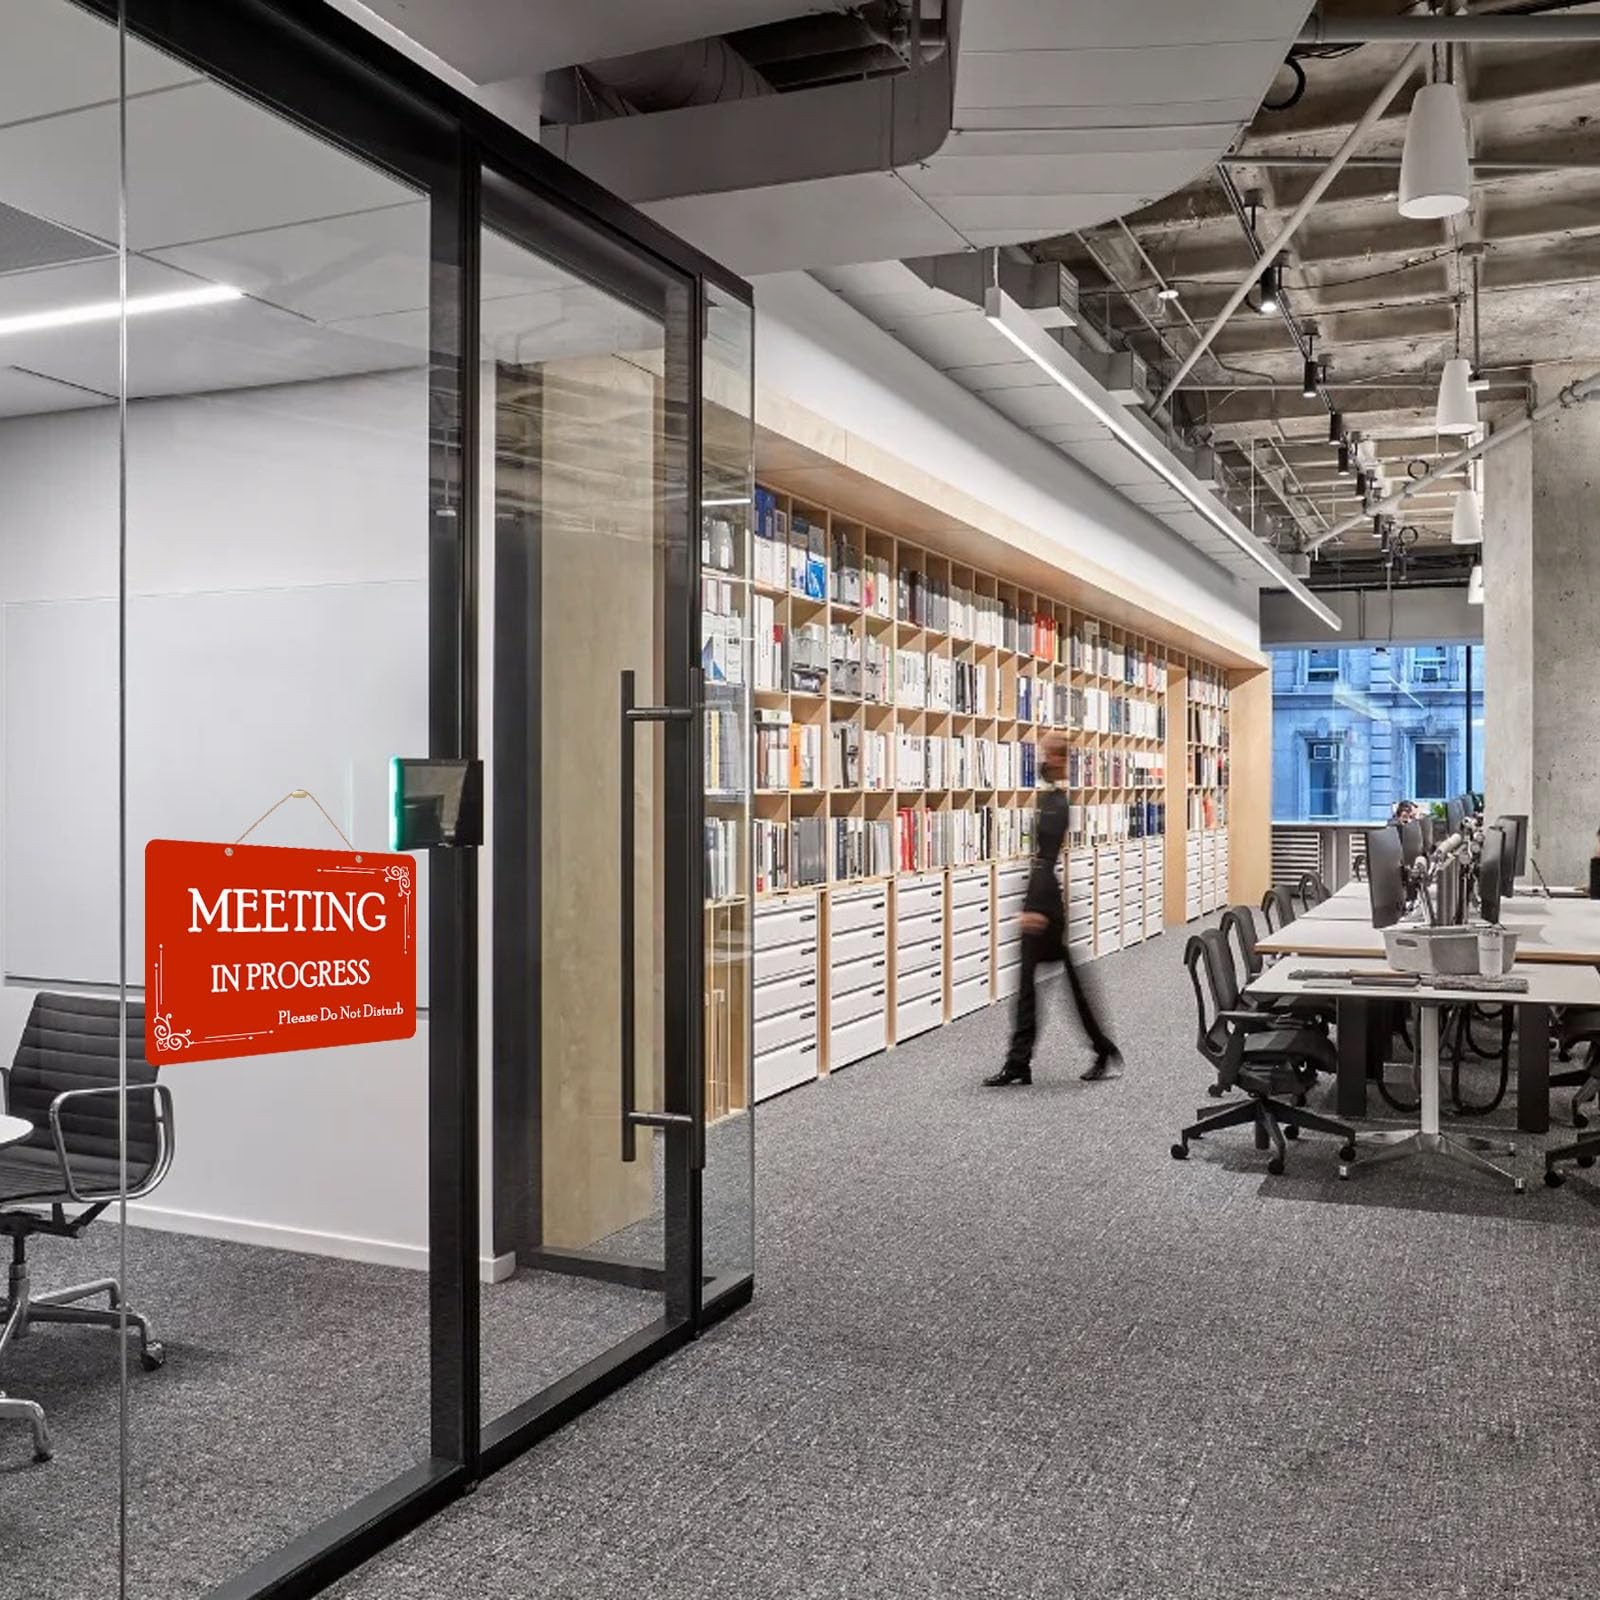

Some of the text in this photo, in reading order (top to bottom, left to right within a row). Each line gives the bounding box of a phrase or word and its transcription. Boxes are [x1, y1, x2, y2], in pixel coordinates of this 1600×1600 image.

[188, 888, 386, 932] MEETING
[211, 959, 370, 992] IN PROGRESS
[279, 1002, 403, 1024] Please Do Not Disturb
